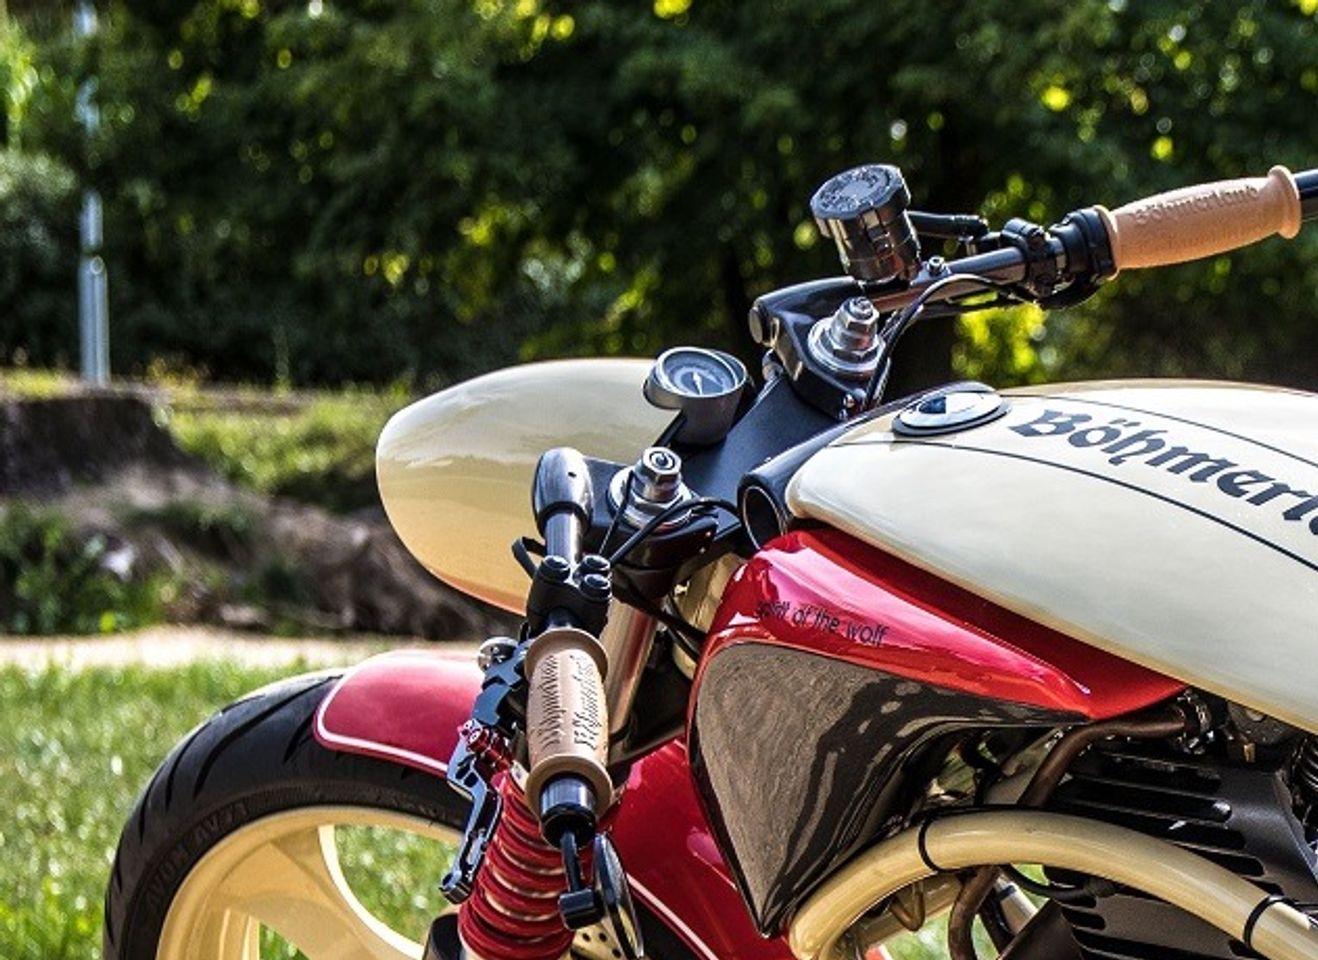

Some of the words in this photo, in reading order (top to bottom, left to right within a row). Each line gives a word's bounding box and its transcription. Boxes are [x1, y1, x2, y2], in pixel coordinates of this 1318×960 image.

[793, 603, 812, 625] of
[813, 608, 841, 631] the
[846, 624, 890, 647] wolf
